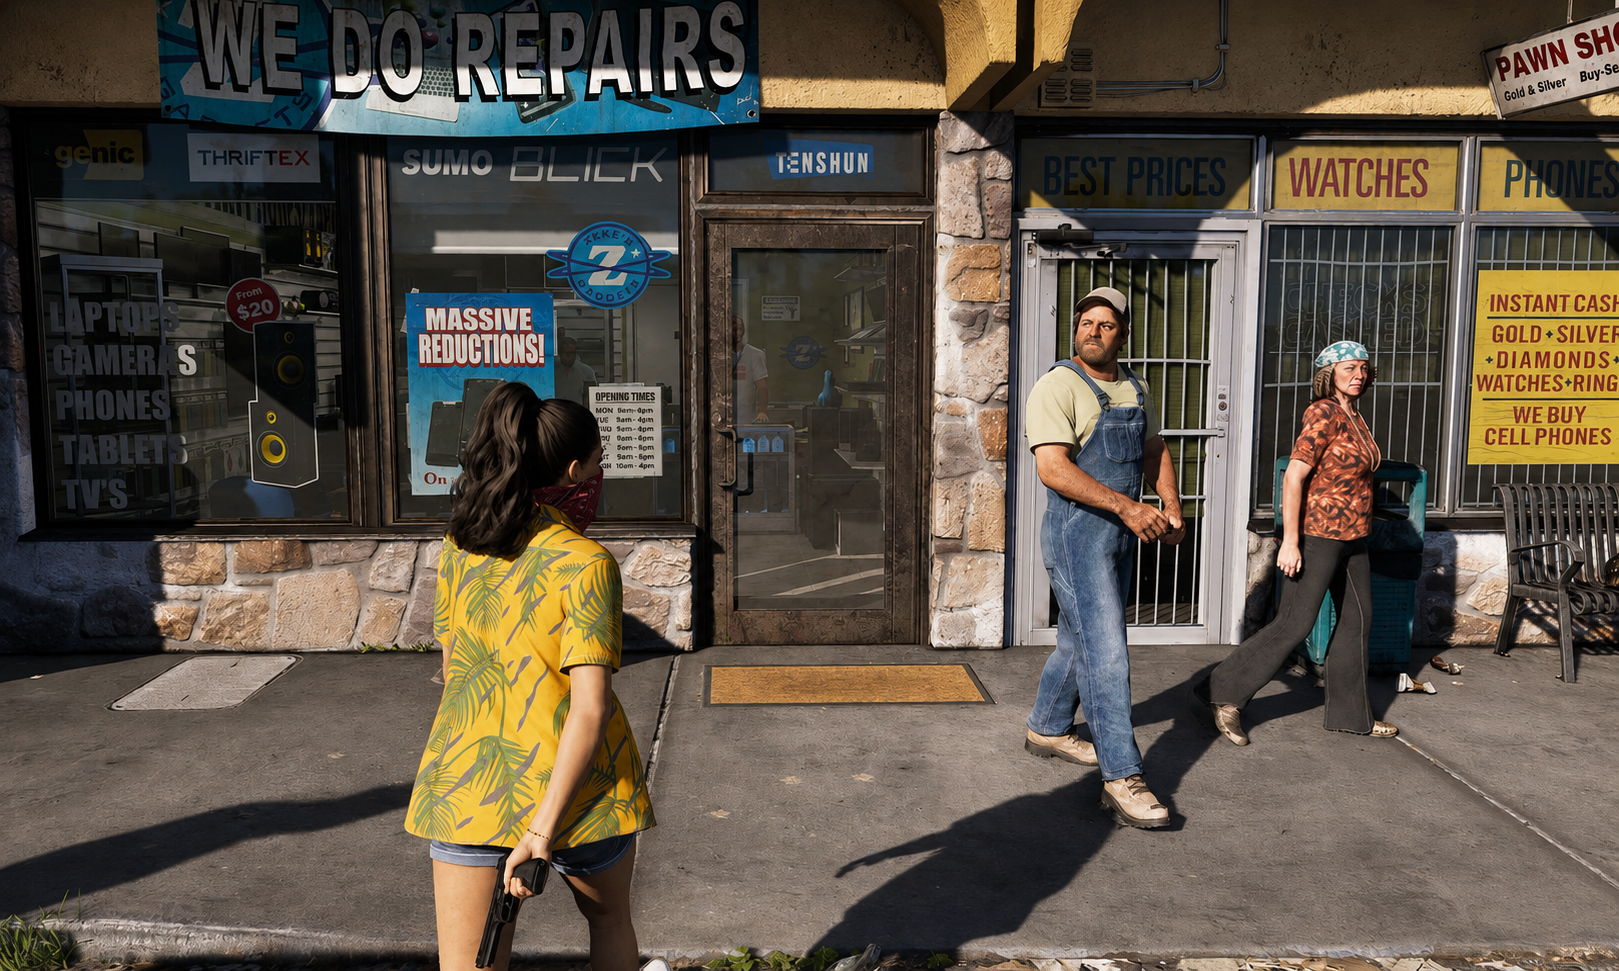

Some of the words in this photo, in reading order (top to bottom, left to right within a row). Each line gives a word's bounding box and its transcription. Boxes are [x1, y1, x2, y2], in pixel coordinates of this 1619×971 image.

[191, 0, 303, 93] WE
[330, 8, 424, 101] DO
[453, 1, 746, 101] REPAIRS
[1495, 39, 1570, 82] PAWN
[1504, 85, 1526, 101] Gold
[1527, 84, 1536, 96] &
[1537, 77, 1567, 93] Silver
[54, 140, 136, 169] genic
[197, 149, 312, 166] THRIFTEX
[401, 149, 494, 176] SUMO
[509, 146, 668, 182] BLICK
[775, 152, 869, 174] TENSHUN
[1043, 156, 1116, 196] BEST
[1126, 157, 1226, 197] PRICES
[1288, 157, 1429, 198] WATCHES
[1503, 159, 1619, 199] PHONES
[235, 286, 263, 301] From
[1489, 294, 1571, 312] INSTANT
[51, 301, 180, 333] LAPTOPS
[235, 298, 274, 321] $20
[425, 306, 532, 331] MASSIVE
[1492, 325, 1542, 343] GOLD
[1556, 325, 1619, 343] SILVER
[53, 344, 198, 376] CAMERAS
[418, 333, 545, 367] REDUCTIONS!
[1496, 351, 1610, 369] DIAMONDS
[1476, 374, 1564, 392] WATCHES
[55, 389, 171, 421] PHONES
[595, 392, 630, 402] OPENING
[631, 392, 656, 402] TIMES
[1513, 406, 1543, 424] WE
[1547, 406, 1587, 424] BUY
[57, 434, 189, 465] TABLETS
[1484, 428, 1531, 446] CELL
[1535, 428, 1612, 446] PHONES
[424, 472, 448, 485] On
[61, 478, 129, 510] TV'S
